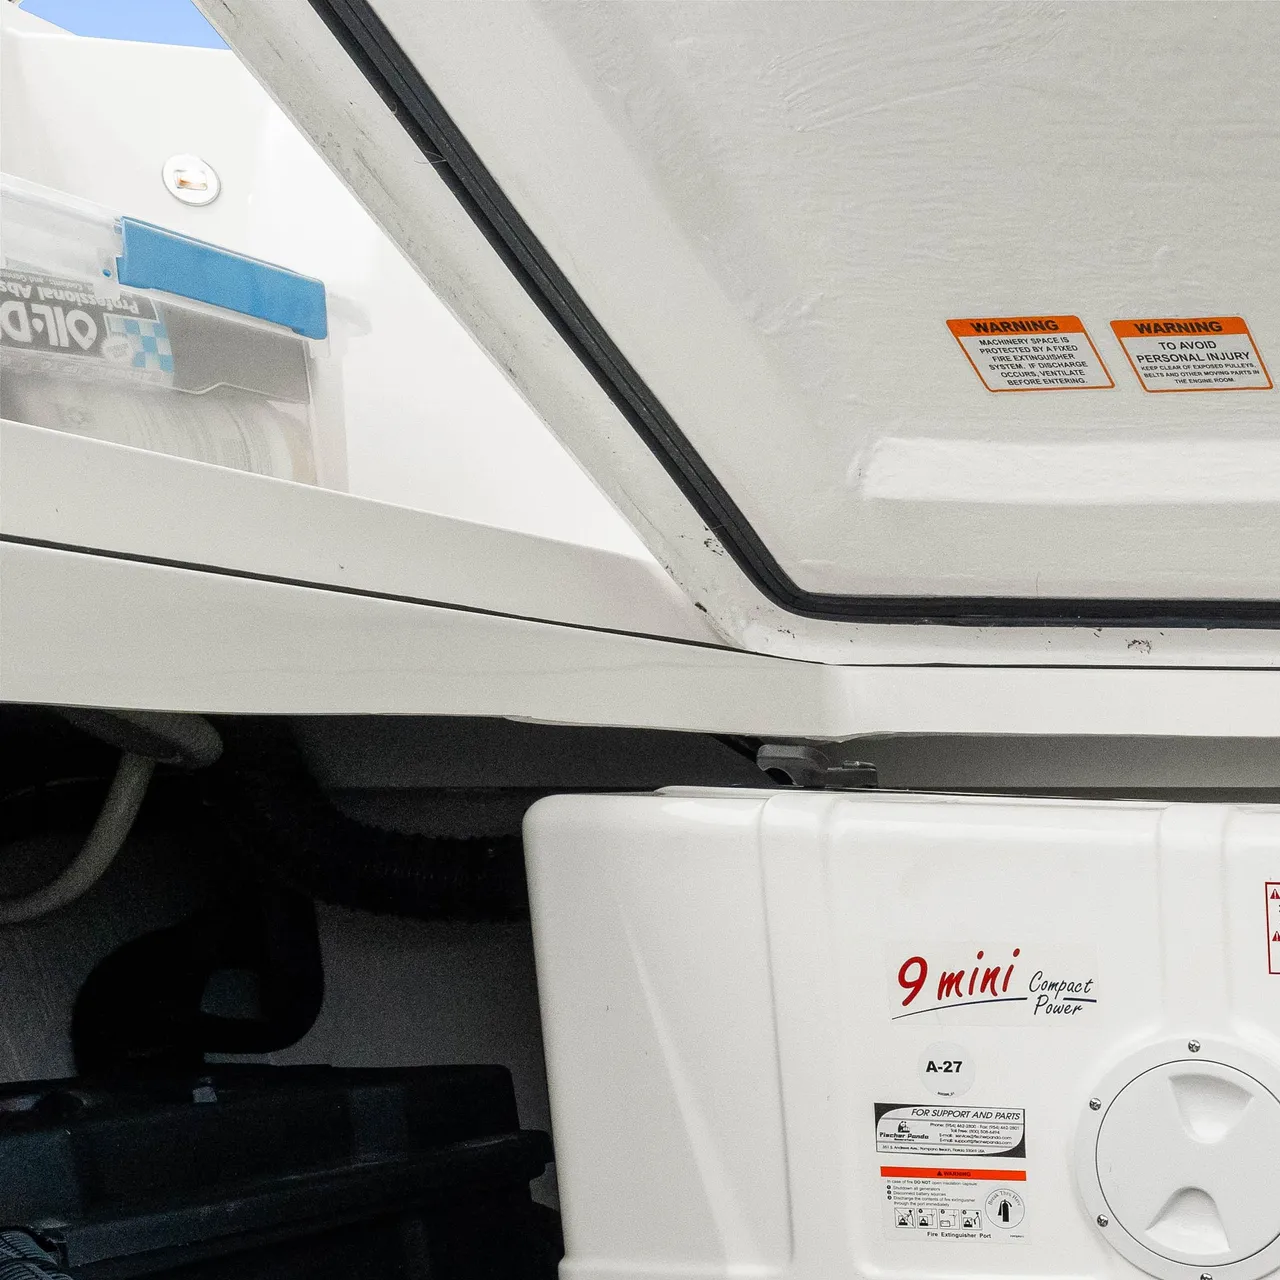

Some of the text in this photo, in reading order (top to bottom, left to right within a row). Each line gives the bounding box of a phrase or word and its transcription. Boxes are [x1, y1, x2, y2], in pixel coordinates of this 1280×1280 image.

[970, 320, 1060, 333] WARNING
[1134, 321, 1224, 334] WARNING
[979, 336, 1070, 346] MACHINERY SPACE IS
[1158, 340, 1217, 351] TO AVOID
[979, 346, 1031, 354] PROTECTED
[1033, 345, 1045, 353] BY
[1053, 344, 1079, 352] FIXED
[992, 353, 1076, 363] FIRE EXTINGUISHER
[1136, 351, 1251, 364] PERSONAL INJURY
[989, 363, 1026, 371] SYSTEM.
[1037, 361, 1089, 369] DISCHARGE
[1040, 369, 1086, 377] VENTILATE
[1006, 377, 1088, 386] BEFORE ENTERING.
[898, 948, 1021, 1007] 9 mini
[1028, 970, 1095, 1000] Compact
[1033, 993, 1083, 1015] Power
[925, 1060, 963, 1073] A-27
[911, 1108, 1021, 1120] FOR SUPPORT AND PARTS
